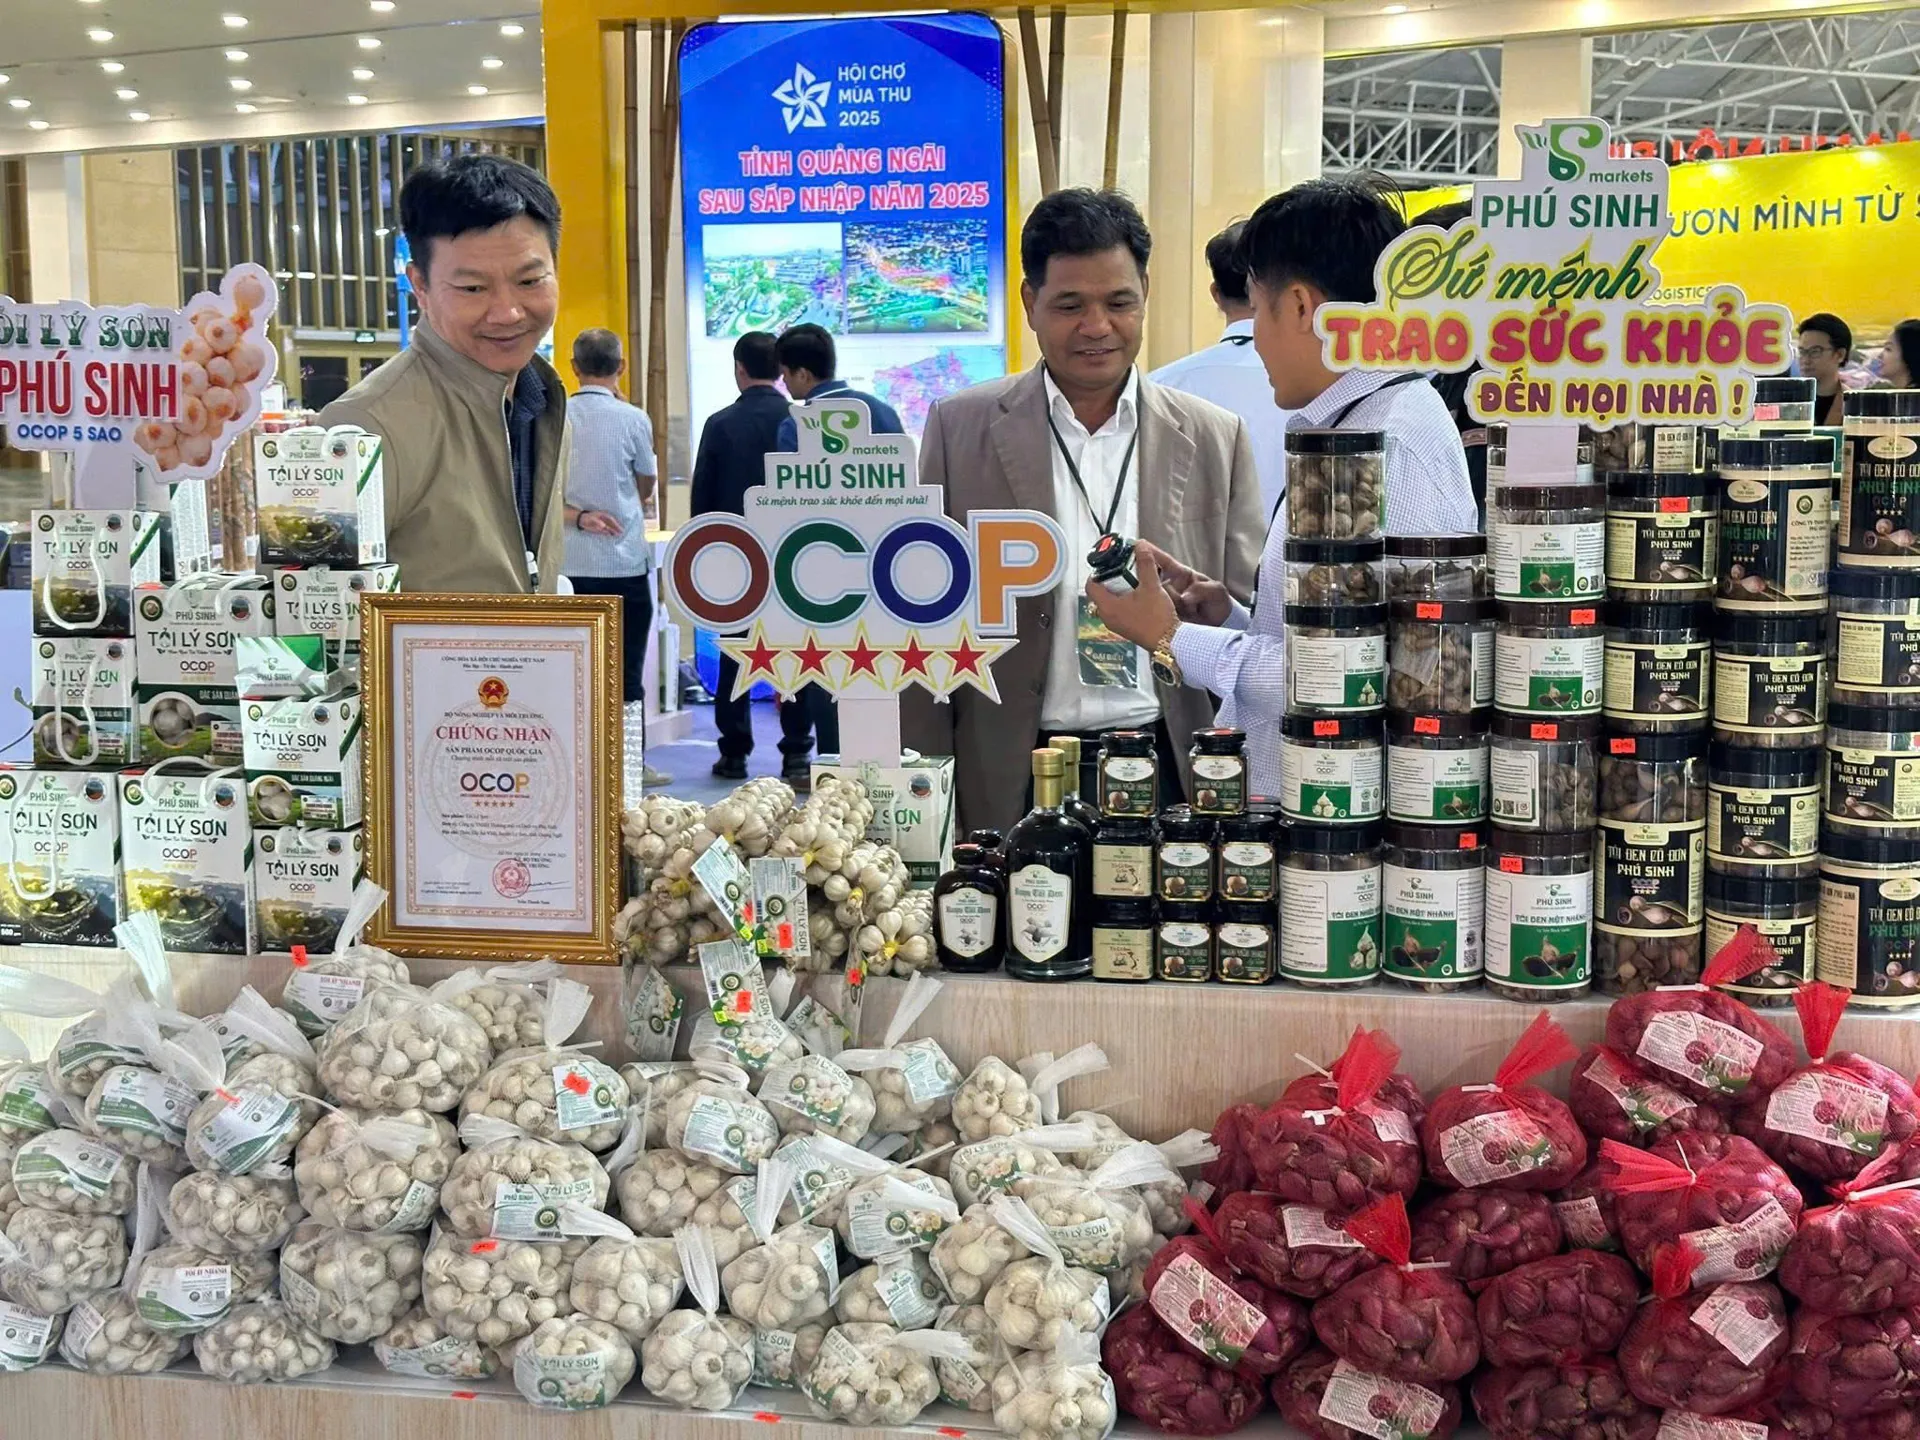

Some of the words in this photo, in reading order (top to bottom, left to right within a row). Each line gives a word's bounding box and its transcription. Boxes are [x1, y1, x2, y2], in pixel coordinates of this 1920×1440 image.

[838, 65, 867, 82] HỘI
[870, 62, 906, 80] CHỢ
[838, 84, 874, 104] MÙA
[877, 86, 911, 102] THU
[839, 111, 880, 126] 2025
[739, 145, 793, 178] TỈNH
[797, 143, 879, 176] QUẢNG
[887, 143, 946, 173] NGÃI
[1589, 169, 1654, 184] markets
[699, 188, 744, 214] SAU
[749, 184, 795, 213] SÁP
[800, 181, 865, 215] NHẬP
[870, 181, 921, 210] NĂM
[929, 183, 989, 208] 2025
[1481, 187, 1556, 230] PHÚ
[1569, 194, 1659, 229] SINH
[1669, 206, 1740, 237] ƯƠN
[1753, 195, 1842, 231] MÌNH
[1854, 184, 1904, 223] TỪ
[1653, 286, 1712, 300] OGISTIC
[40, 311, 86, 346] LÝ
[99, 313, 171, 347] SƠN
[1325, 316, 1469, 366] TRAO
[1491, 303, 1603, 365] SỨC
[1626, 301, 1782, 365] KHỎE
[0, 351, 72, 416] PHÚ
[84, 362, 177, 418] SINH
[1479, 367, 1555, 415] ĐẾN
[1564, 383, 1628, 421] MỌI
[1641, 374, 1718, 415] NHÀ
[1732, 384, 1744, 415] !
[17, 424, 68, 439] OCOP
[73, 426, 83, 440] 5
[88, 426, 122, 442] SAO
[852, 445, 899, 455] markets
[295, 465, 310, 481] LÝ
[314, 467, 344, 481] SƠN
[776, 458, 831, 490] PHÚ
[841, 463, 905, 489] SINH
[1859, 480, 1885, 494] PHÚ
[756, 495, 770, 506] Sứ
[772, 495, 798, 508] mệnh
[800, 497, 821, 506] trao
[823, 494, 838, 506] sức
[884, 496, 903, 508] mọi
[1744, 528, 1777, 541] SINH
[1672, 541, 1693, 549] SINH
[673, 521, 1059, 625] OCOP
[195, 611, 216, 621] SINH
[148, 628, 176, 648] TỎI
[182, 629, 200, 648] LÝ
[180, 661, 215, 671] OCOP
[1670, 672, 1690, 680] SINH
[1765, 684, 1783, 693] PHÚ
[254, 730, 275, 745] TỎI
[279, 731, 294, 745] LÝ
[298, 734, 327, 747] SƠN
[436, 722, 498, 740] CHỨNG
[503, 726, 551, 745] NHẬN
[460, 772, 530, 793] OCOP
[1856, 777, 1878, 787] SINH
[873, 790, 894, 799] SINH
[158, 798, 177, 808] PHÚ
[178, 799, 199, 808] SINH
[62, 813, 97, 829] SƠN
[133, 813, 161, 834] TỎI
[167, 815, 185, 834] LÝ
[190, 819, 227, 837] SƠN
[1733, 815, 1750, 824] PHÚ
[1753, 817, 1775, 825] SINH
[163, 848, 197, 859] OCOP
[1625, 848, 1646, 861] ĐEN
[1650, 847, 1664, 862] CÔ
[1667, 847, 1687, 862] ĐƠN
[266, 860, 287, 875] TỎI
[292, 861, 306, 876] LÝ
[310, 863, 339, 877] SƠN
[1617, 863, 1641, 876] PHÚ
[1645, 866, 1675, 877] SINH
[1400, 890, 1414, 899] PHÚ
[1416, 892, 1434, 900] SINH
[1427, 908, 1455, 918] NHÁNH
[1886, 909, 1902, 921] ĐEN
[1868, 924, 1897, 937] PHÚ
[1774, 947, 1794, 955] SINH
[574, 1182, 591, 1194] SƠN
[1085, 1223, 1107, 1236] SƠN
[771, 1335, 791, 1347] SƠN
[577, 1356, 599, 1368] SƠN
